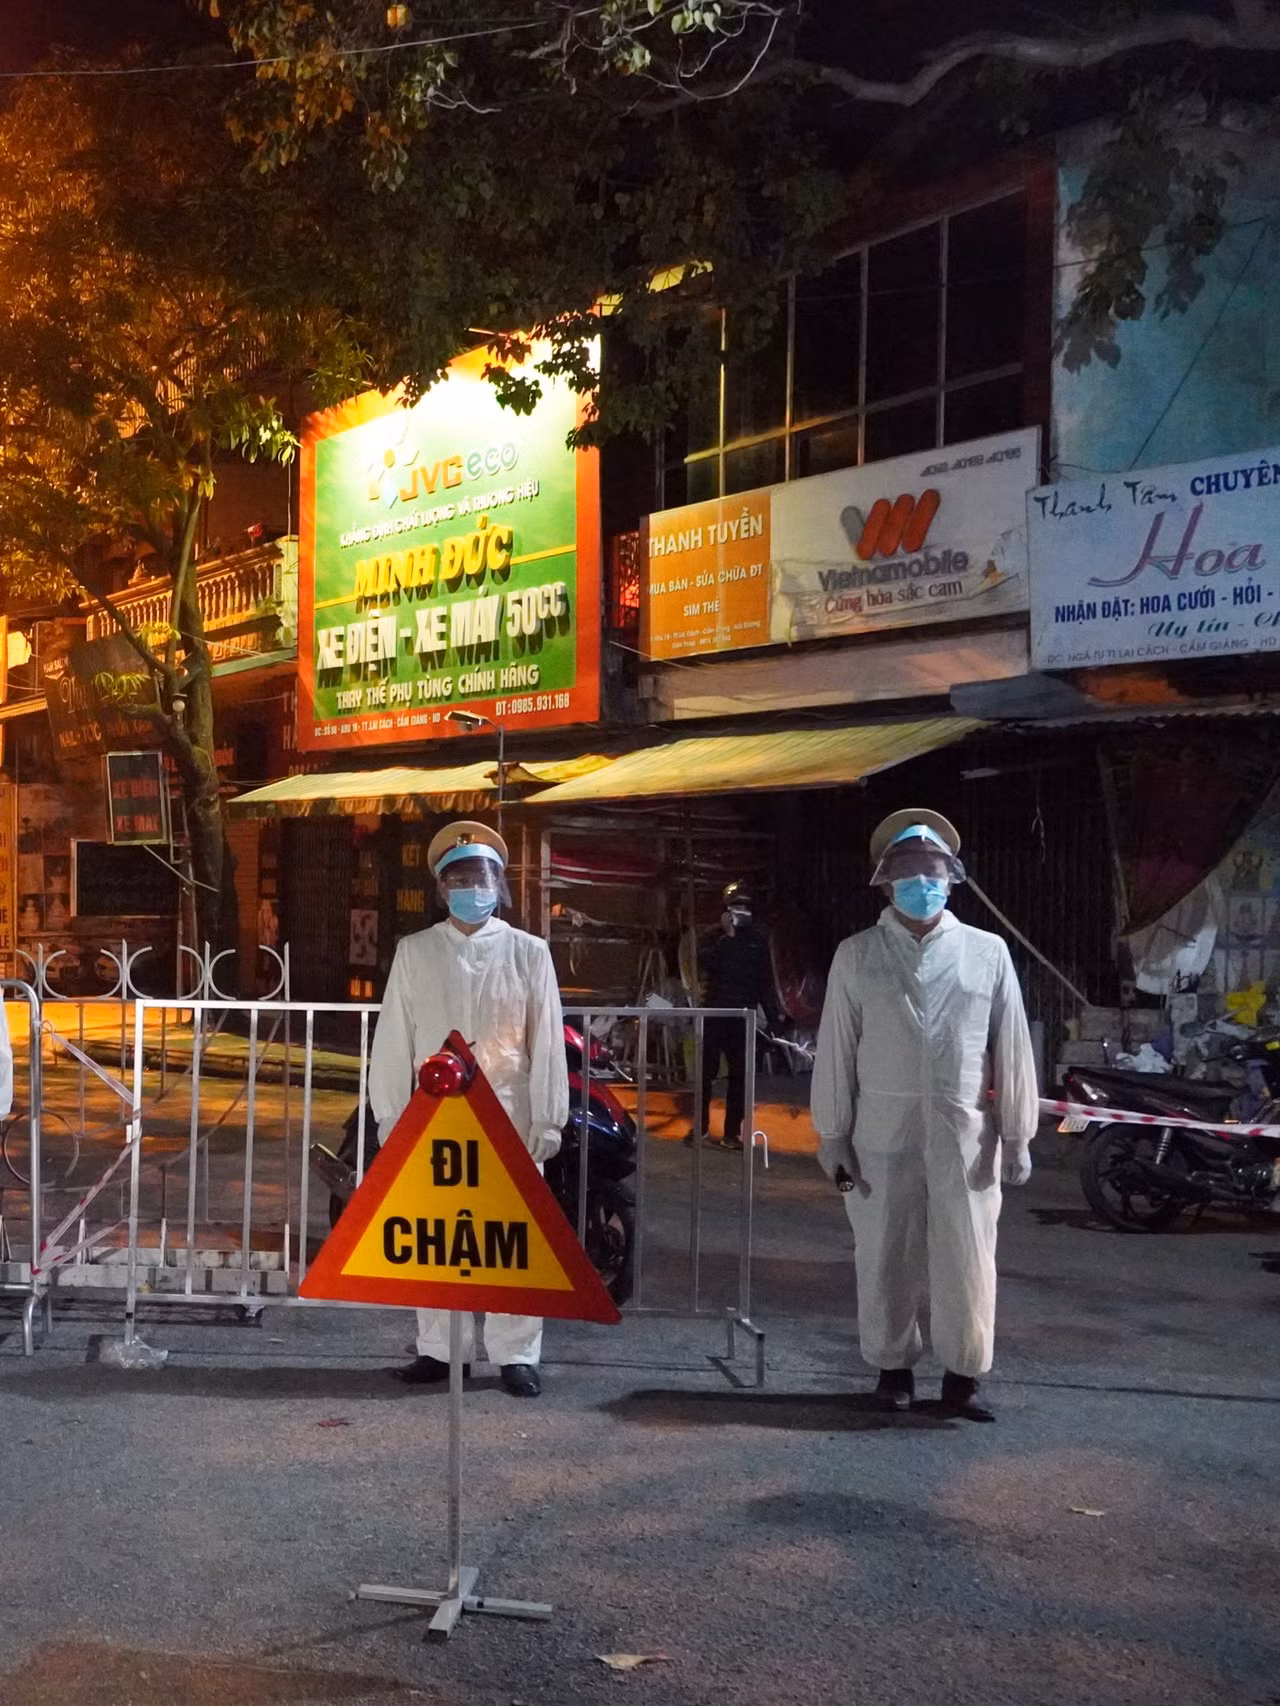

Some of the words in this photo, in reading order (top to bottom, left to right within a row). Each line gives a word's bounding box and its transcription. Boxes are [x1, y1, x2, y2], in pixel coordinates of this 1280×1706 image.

[708, 507, 763, 546] TUYỀN
[1087, 499, 1267, 588] Hoa
[354, 544, 439, 600] MINH
[441, 514, 514, 581] ĐỨC
[818, 548, 969, 592] Vietnamobile
[683, 602, 700, 617] SIM
[929, 581, 963, 597] cam
[1054, 600, 1097, 625] NHẬN
[1101, 597, 1136, 622] ĐẶT:
[1140, 594, 1172, 615] HOA
[1177, 584, 1216, 612] CƯỚI
[415, 606, 448, 655] XE
[417, 675, 453, 700] TÙNG
[458, 667, 496, 695] CHÍNH
[500, 659, 540, 689] HÃNG
[431, 1138, 478, 1187] ĐI
[383, 1209, 528, 1277] CHẬM
